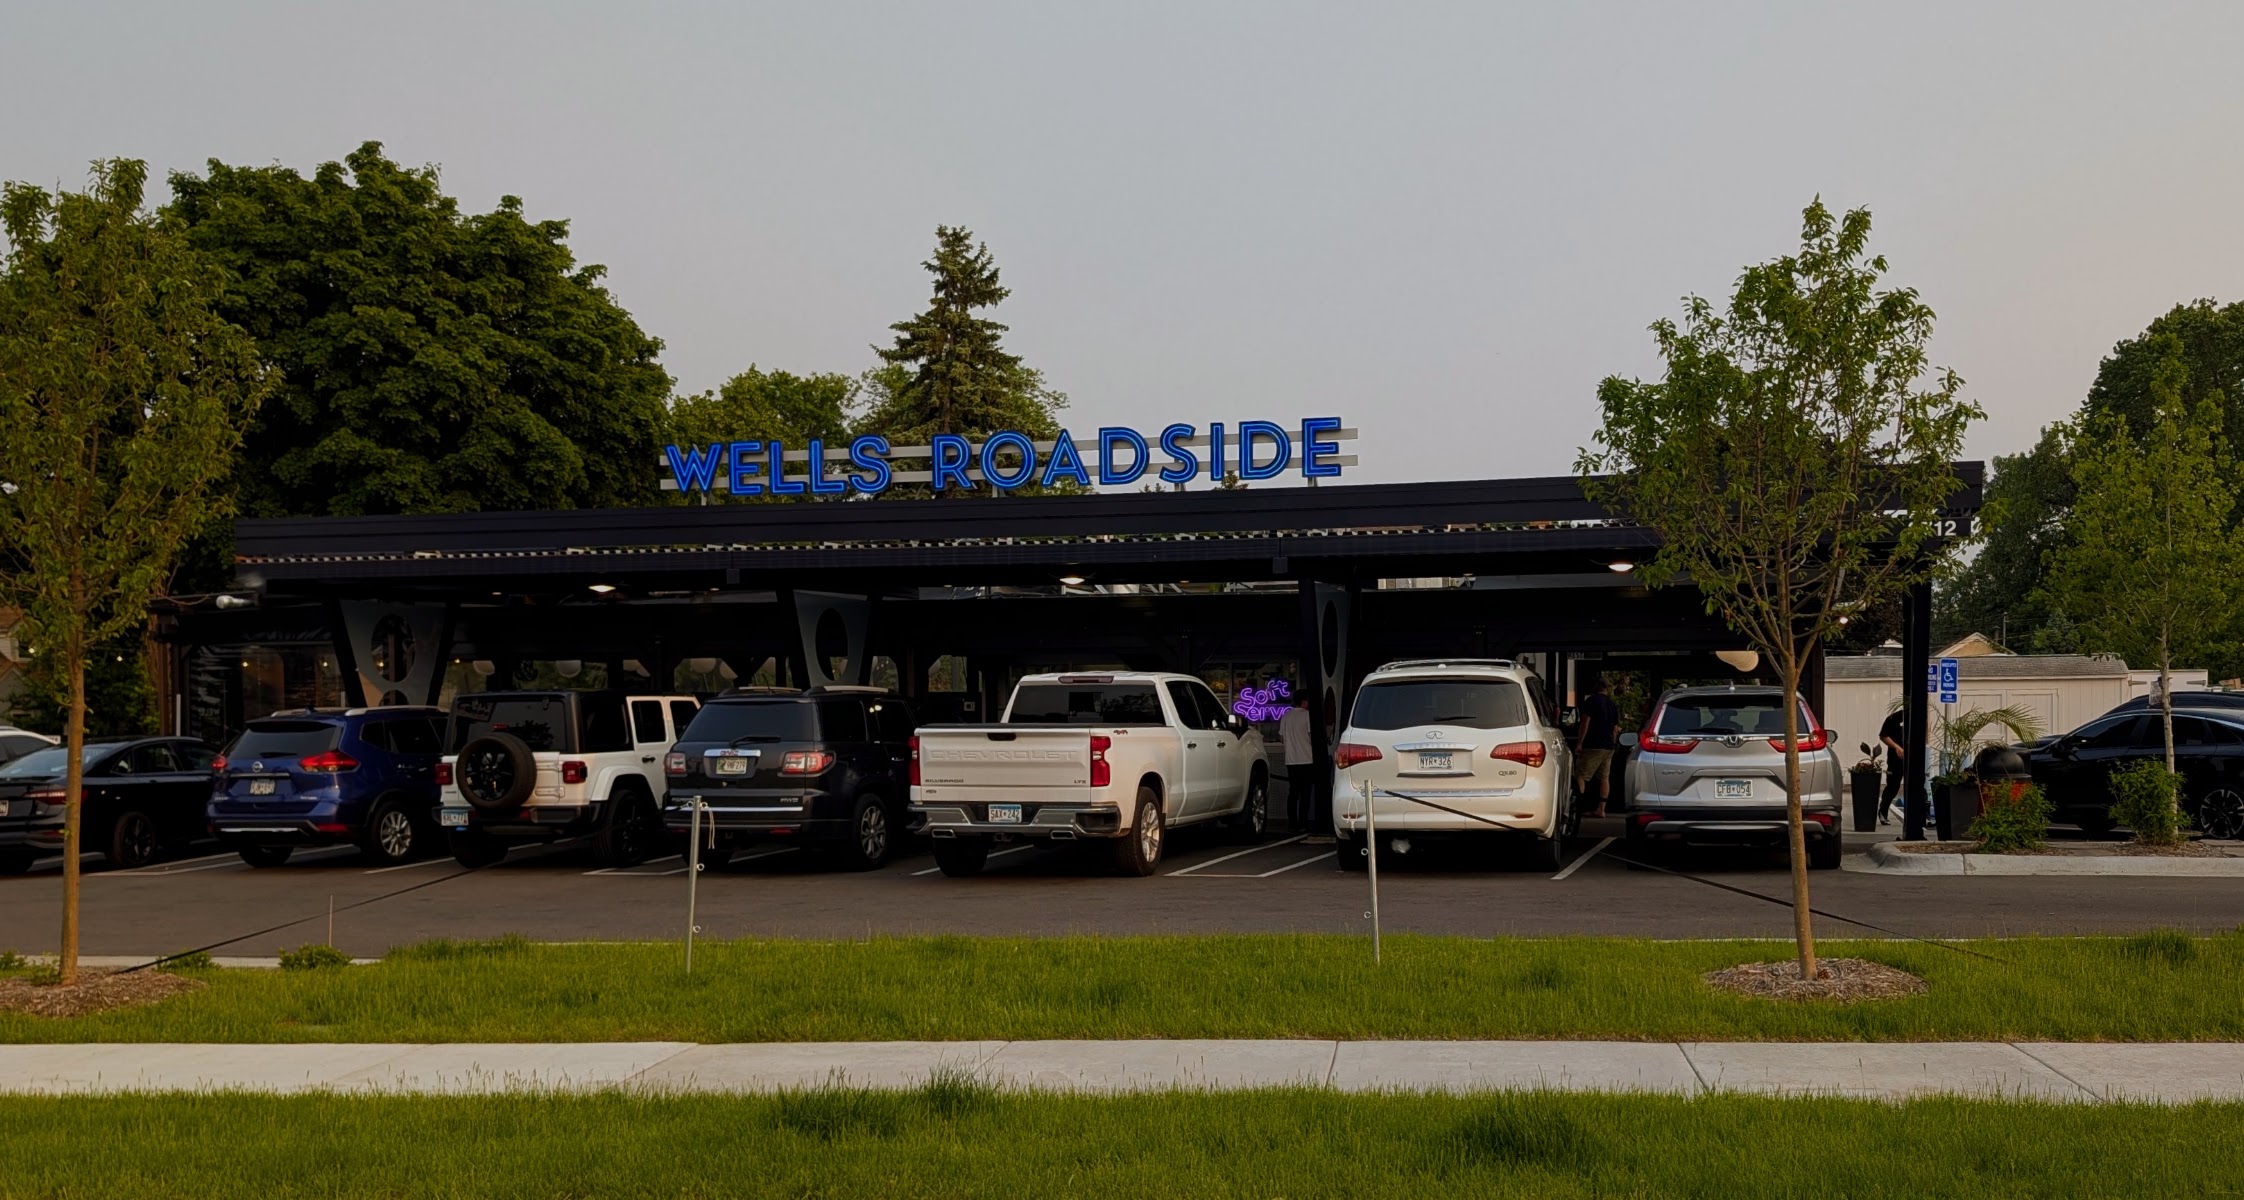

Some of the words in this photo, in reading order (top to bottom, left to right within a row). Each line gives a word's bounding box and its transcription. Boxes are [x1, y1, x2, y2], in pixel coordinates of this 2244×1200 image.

[665, 434, 892, 495] WELLS
[931, 417, 1342, 491] ROADSIDE
[1240, 680, 1291, 709] Soft
[930, 750, 1078, 761] CHEVROLET
